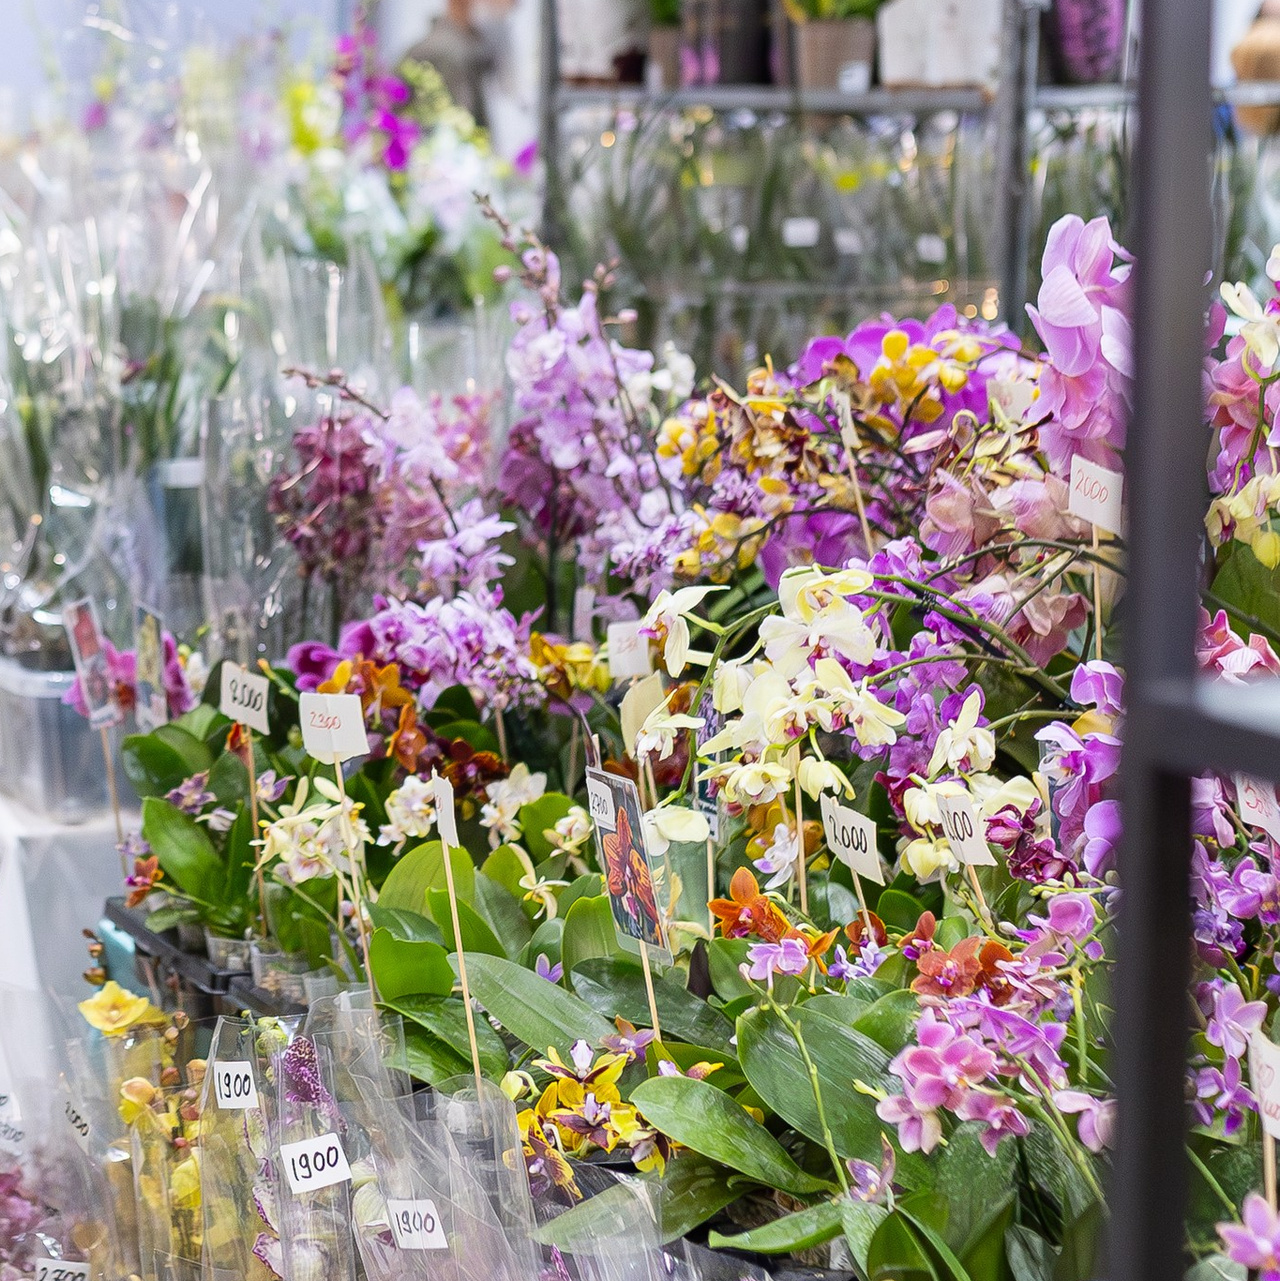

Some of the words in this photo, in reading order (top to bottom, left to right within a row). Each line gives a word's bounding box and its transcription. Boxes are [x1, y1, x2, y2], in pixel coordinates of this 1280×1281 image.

[1075, 466, 1109, 504] 2000
[829, 815, 867, 854] 2000
[217, 1072, 251, 1100] 1900
[291, 1146, 339, 1181] 1900
[395, 1210, 435, 1237] 1900
